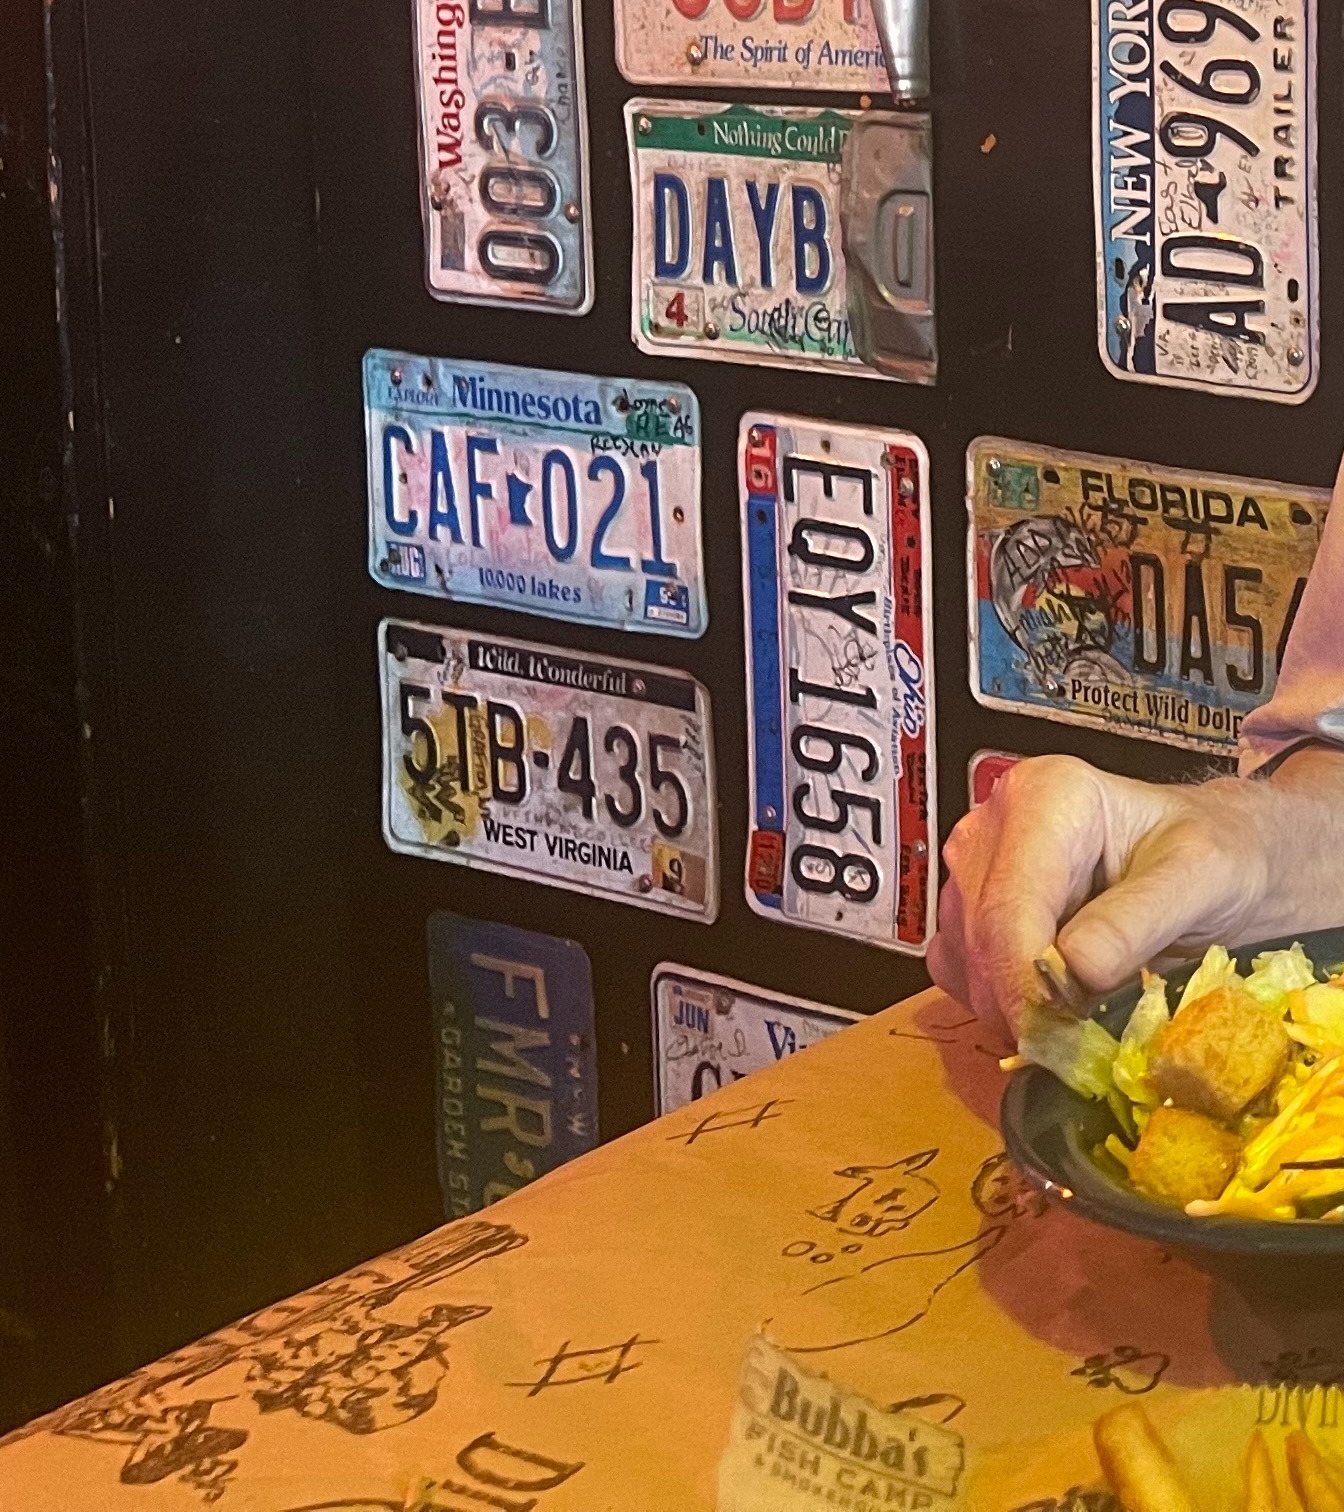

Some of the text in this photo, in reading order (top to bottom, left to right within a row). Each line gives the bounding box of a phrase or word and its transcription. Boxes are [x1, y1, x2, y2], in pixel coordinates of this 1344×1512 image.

[700, 35, 814, 67] The Spirit of
[1273, 14, 1296, 208] TRAILER
[712, 120, 838, 162] Nothing Could
[1108, 115, 1151, 245] NEW
[664, 291, 689, 329] 4
[1158, 233, 1266, 345] AD
[451, 374, 602, 426] Minnesota
[383, 425, 678, 578] CAF 021
[1080, 469, 1269, 532] FLORIDA
[529, 573, 582, 605] lakes
[528, 656, 628, 696] Wonderful
[1070, 678, 1190, 726] Protect Wild
[786, 667, 884, 906] 1658
[483, 817, 634, 876] WEST VIRGINIA
